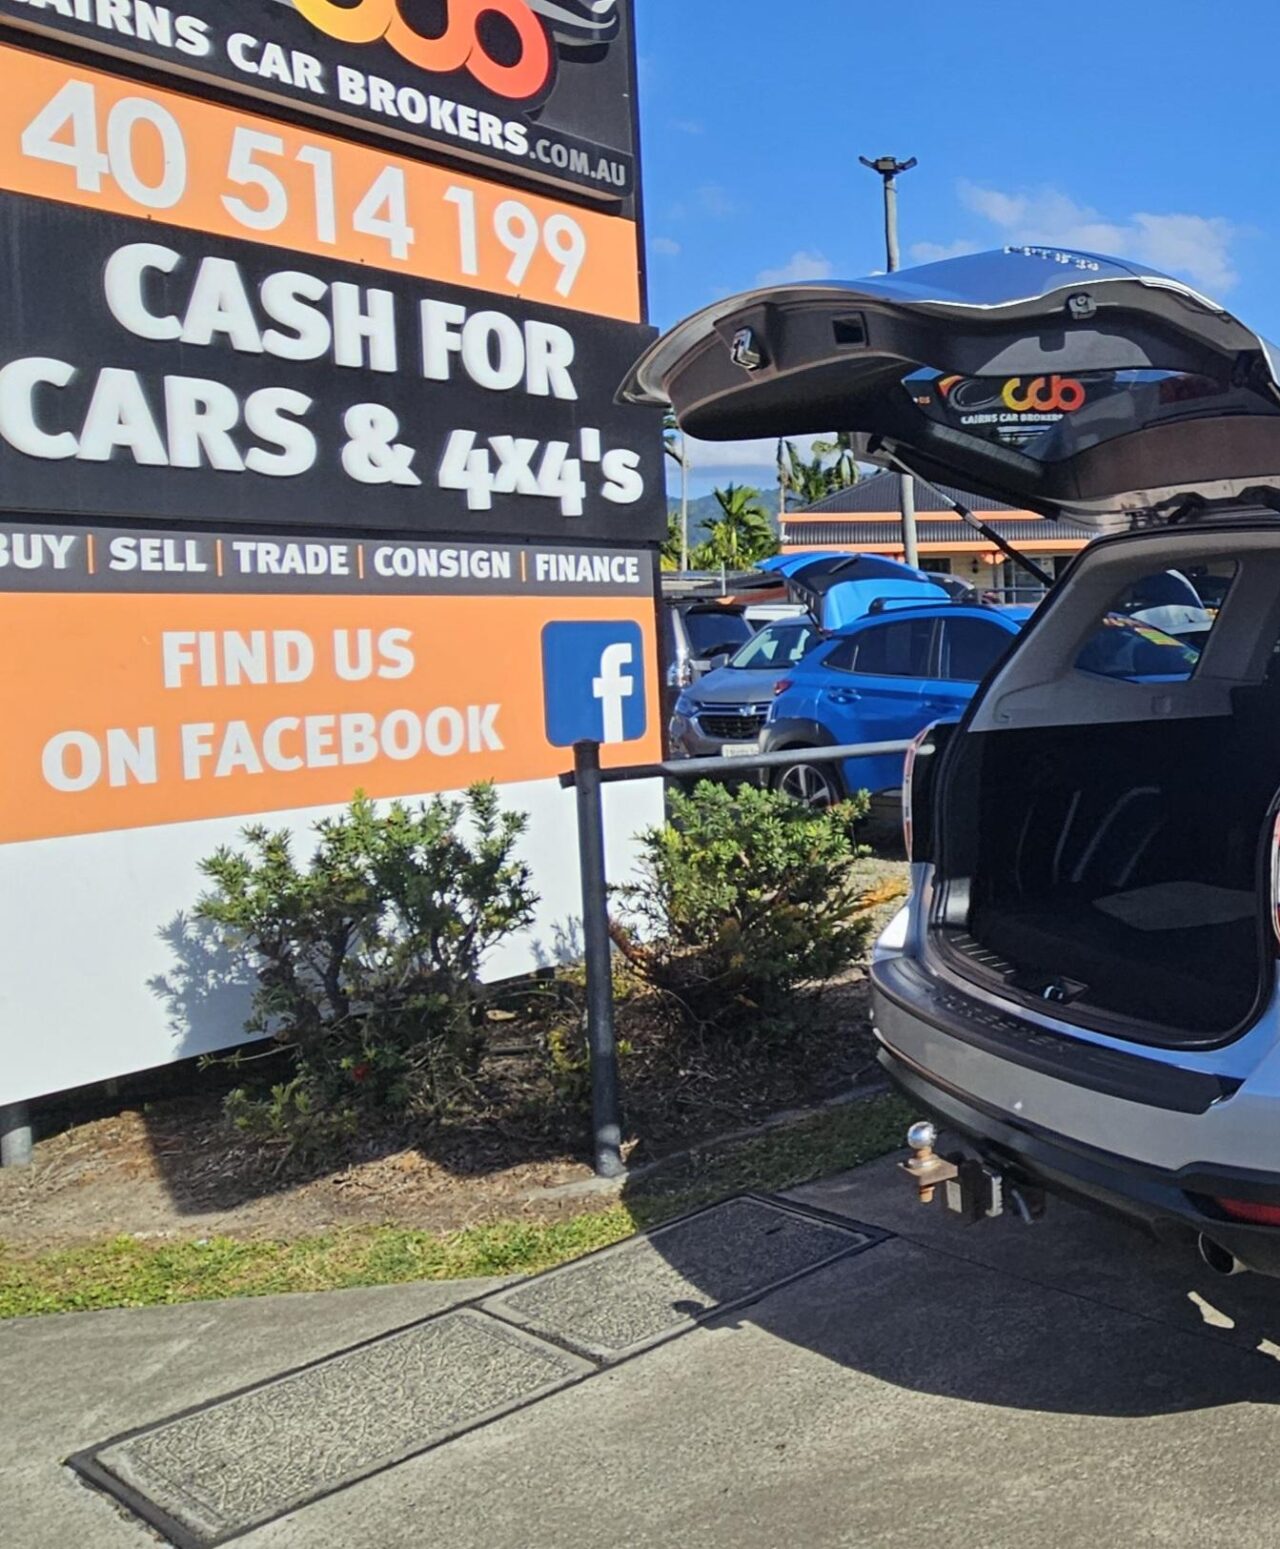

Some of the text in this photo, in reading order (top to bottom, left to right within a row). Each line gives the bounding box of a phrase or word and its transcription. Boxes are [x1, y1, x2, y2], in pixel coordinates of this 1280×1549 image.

[13, 0, 210, 57] IRNS
[226, 33, 326, 94] CAR
[21, 79, 587, 298] 40 514 199
[104, 243, 578, 400] CASH FOR
[0, 357, 317, 477] CARS
[341, 403, 421, 486] &
[961, 414, 998, 424] CAIRNS
[1000, 413, 1019, 421] CAR
[109, 537, 207, 572] SELL
[232, 541, 349, 576] TRADE
[374, 546, 511, 579] CONSIGN
[535, 553, 640, 583] FINANCE
[162, 628, 415, 689] FIND US
[42, 703, 505, 792] ON FACEBOOK
